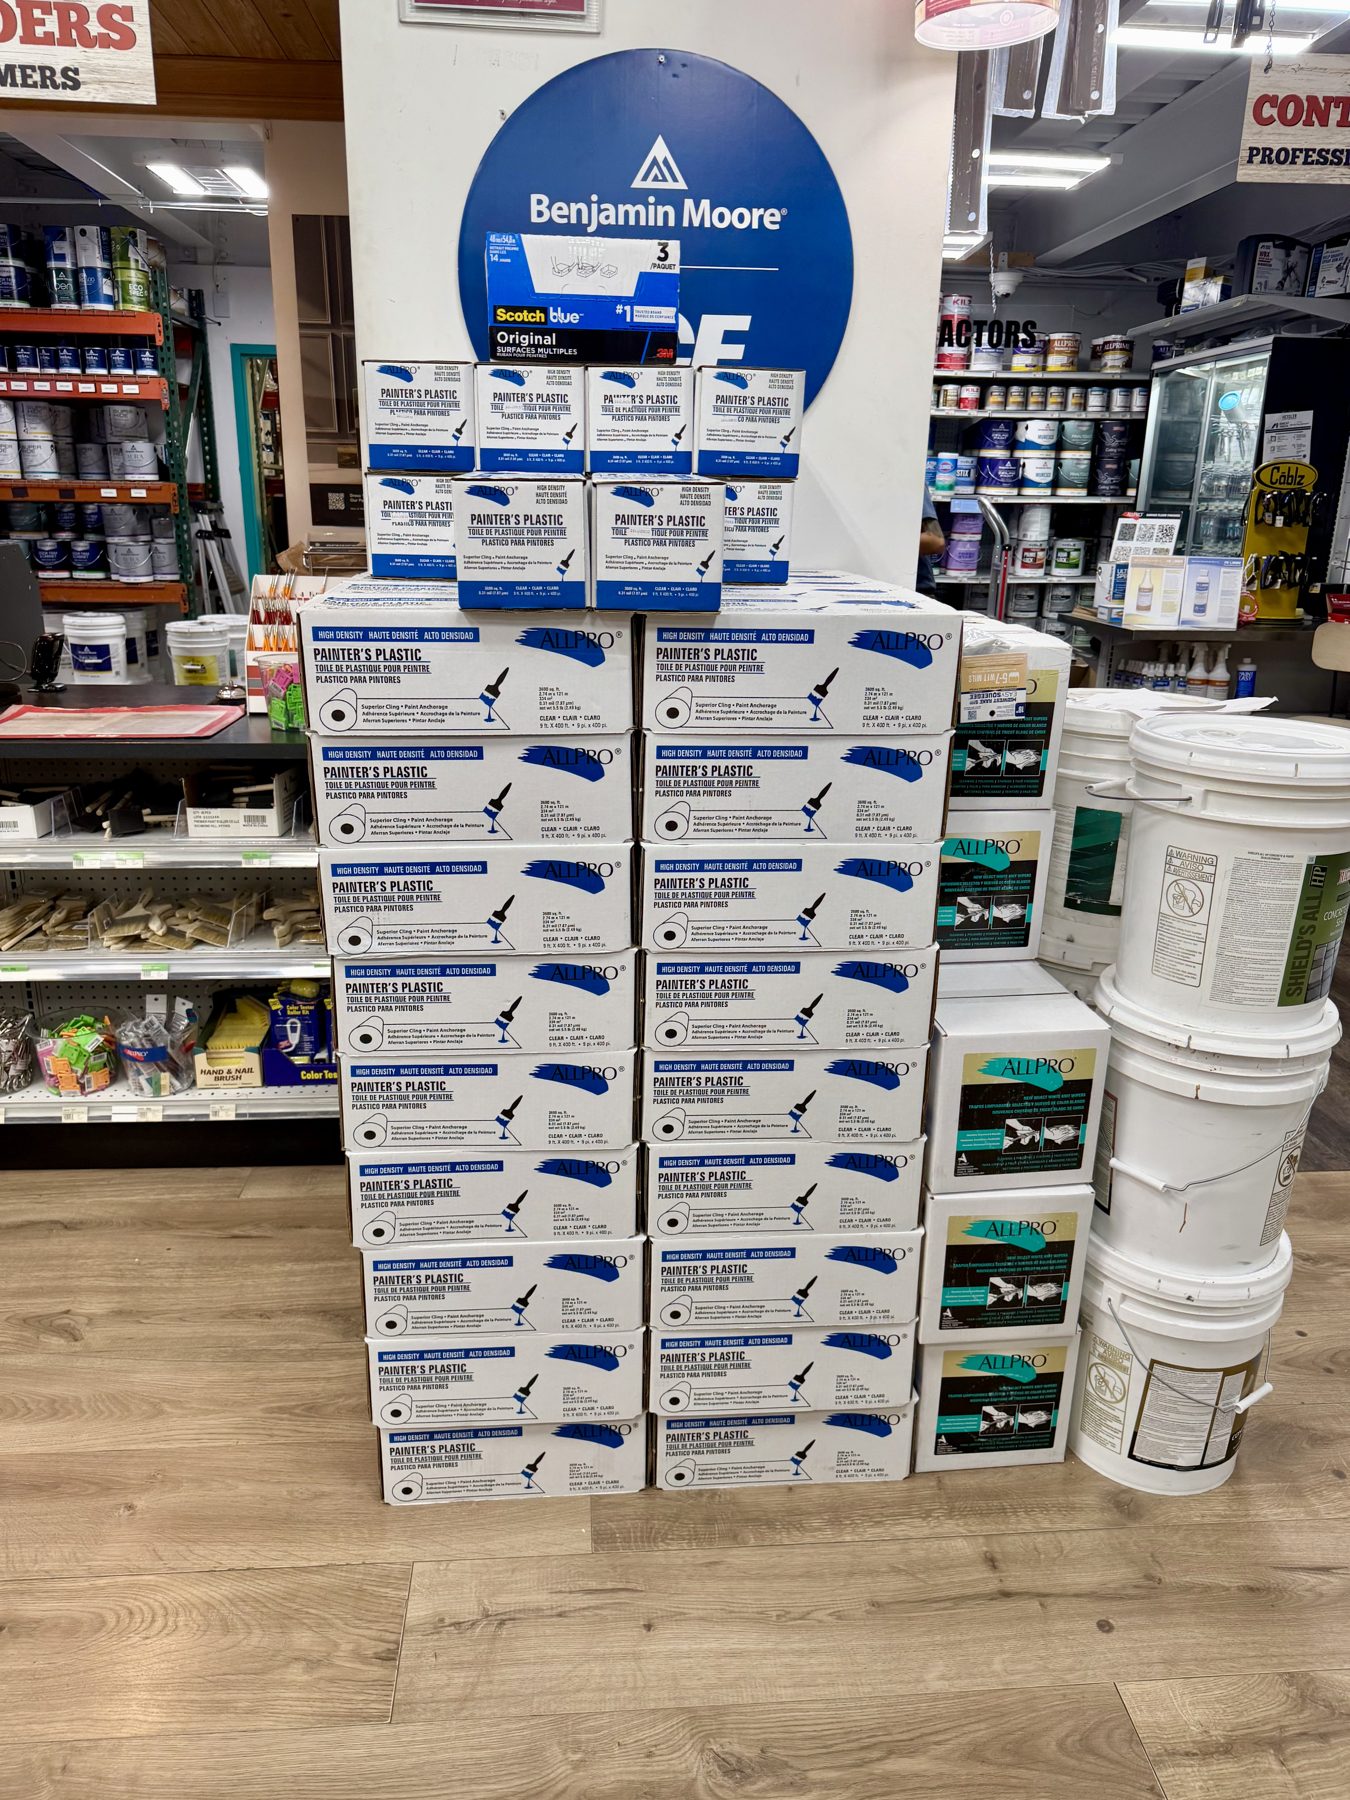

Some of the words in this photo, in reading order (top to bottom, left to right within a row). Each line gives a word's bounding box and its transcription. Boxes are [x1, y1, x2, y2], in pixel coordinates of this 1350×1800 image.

[530, 193, 675, 232] Benjamin
[657, 245, 669, 262] 3
[496, 308, 545, 322] Scotch
[616, 304, 631, 322] #1
[497, 332, 556, 346] Original
[938, 320, 1038, 349] ACTORS
[656, 349, 673, 358] 3M
[381, 388, 422, 398] PAINTER'S
[425, 389, 457, 399] PLASTIC
[646, 395, 678, 404] PLASTIC
[716, 395, 755, 405] PAINTER'S
[757, 397, 789, 407] PLASTIC
[383, 500, 423, 510] PAINTER'S
[747, 507, 778, 516] PLASTIC
[471, 514, 520, 525] PAINTER'S
[524, 514, 563, 526] PLASTIC
[615, 514, 663, 526] PAINTER'S
[667, 515, 706, 527] PLASTIC
[318, 631, 334, 639] HIGH
[336, 631, 363, 639] DENSITY
[369, 631, 389, 639] HAUTE
[392, 629, 418, 640] DENSITÉ
[424, 632, 440, 640] ALTO
[441, 632, 474, 640] DENSIDAD
[314, 648, 371, 660] PAINTER'S
[376, 649, 422, 661] PLASTIC
[657, 648, 710, 660] PAINTER'S
[714, 649, 758, 661] PLASTIC
[346, 665, 382, 673] PLASTIQUE
[384, 665, 402, 673] POUR
[403, 665, 430, 673] PEINTRE
[316, 676, 348, 684] PLASTICO
[350, 676, 367, 684] PARA
[369, 676, 401, 684] PINTORES
[324, 766, 379, 778] PAINTER'S
[383, 766, 428, 778] PLASTIC
[1175, 850, 1214, 865] WARNING
[1180, 861, 1204, 871] AVISO
[1173, 868, 1212, 882] AVERTISSEMENT
[1311, 866, 1325, 887] HP
[654, 878, 705, 889] PAINTER'S
[708, 878, 749, 888] PLASTIC
[1286, 924, 1316, 998] SHIELD'S
[1301, 890, 1324, 922] ALL
[346, 982, 398, 993] PAINTER'S
[402, 982, 443, 993] PLASTIC
[301, 1071, 322, 1079] Color
[653, 1077, 701, 1086] PAINTER'S
[705, 1077, 744, 1086] PLASTIC
[360, 1179, 410, 1190] PAINTER'S
[413, 1178, 453, 1189] PLASTIC
[661, 1265, 707, 1275] PAINTER'S
[710, 1264, 748, 1274] PLASTIC
[378, 1365, 425, 1375] PAINTER'S
[429, 1364, 467, 1374] PLASTIC
[666, 1432, 710, 1442] PAINTER'S
[713, 1431, 749, 1440] PLASTIC
